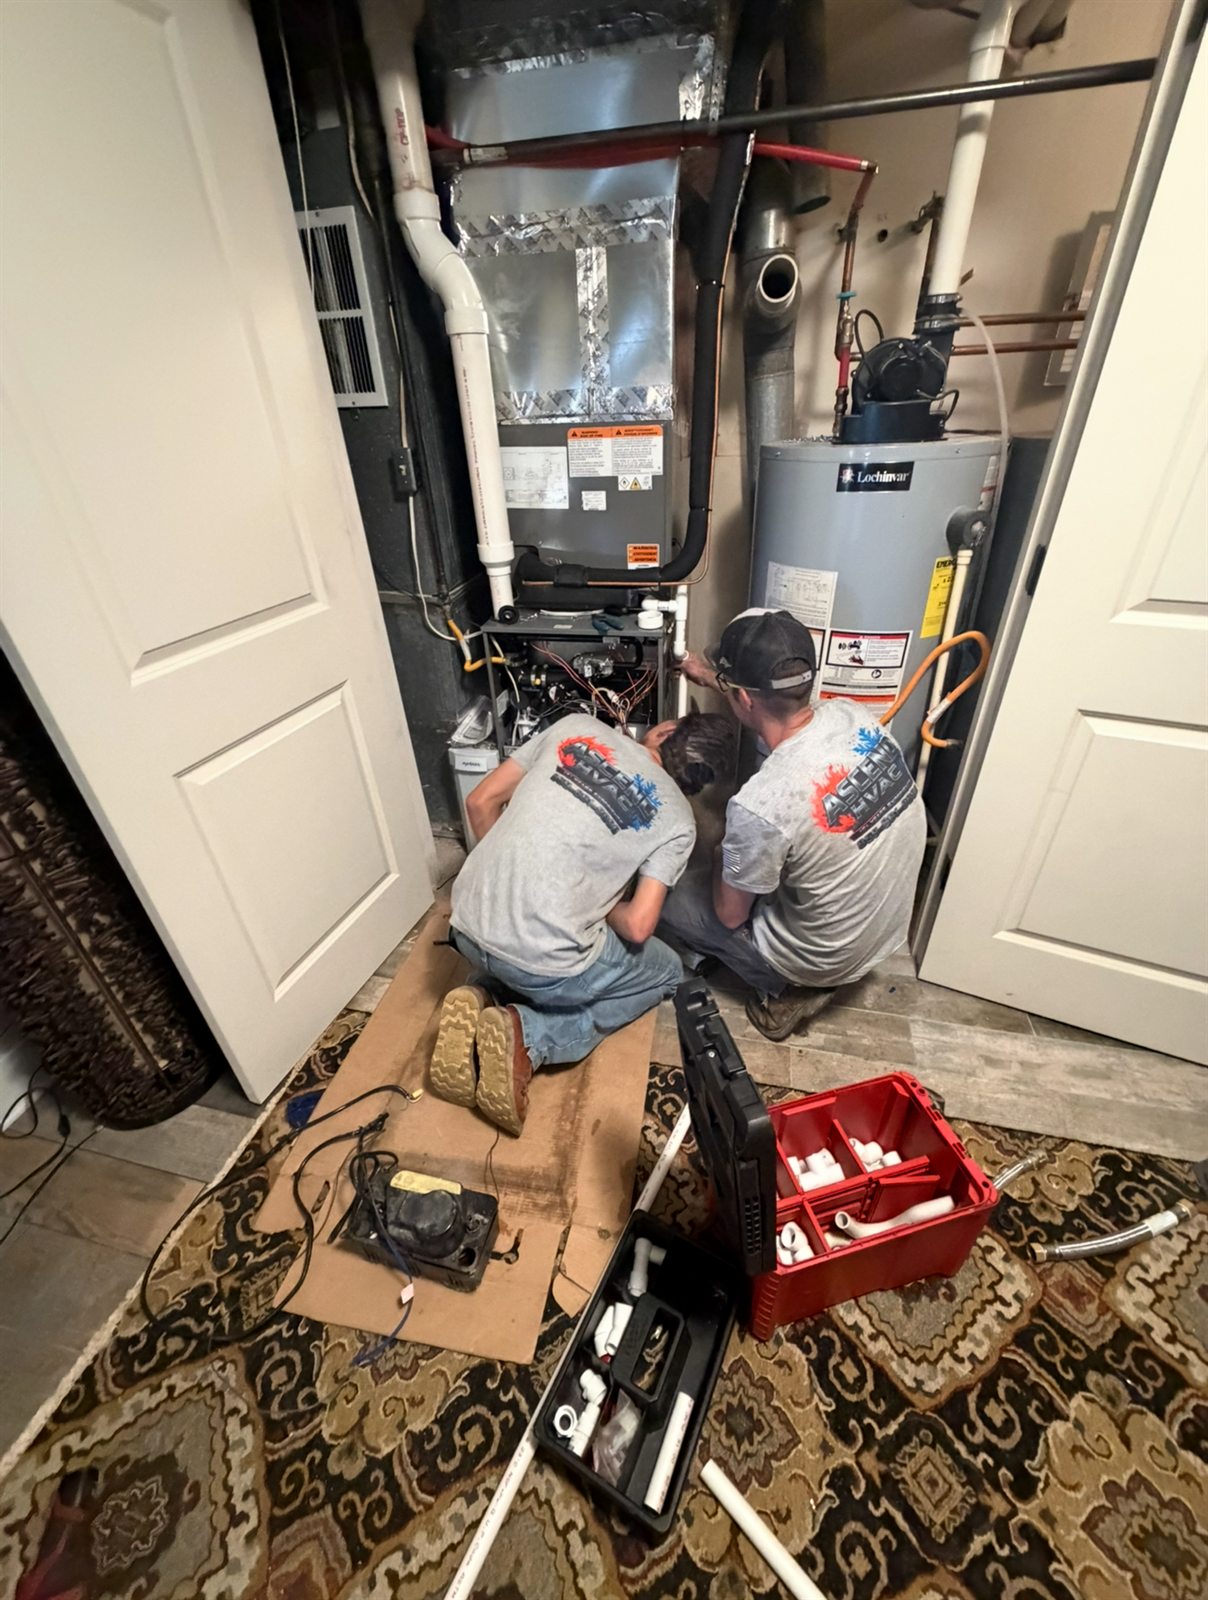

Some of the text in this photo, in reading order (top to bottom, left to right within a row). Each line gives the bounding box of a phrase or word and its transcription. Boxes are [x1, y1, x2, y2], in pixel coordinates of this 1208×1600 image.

[857, 470, 908, 484] Lochinvar
[576, 761, 634, 812] HVAC
[822, 736, 899, 826] ASCEND
[850, 763, 902, 819] HVAC
